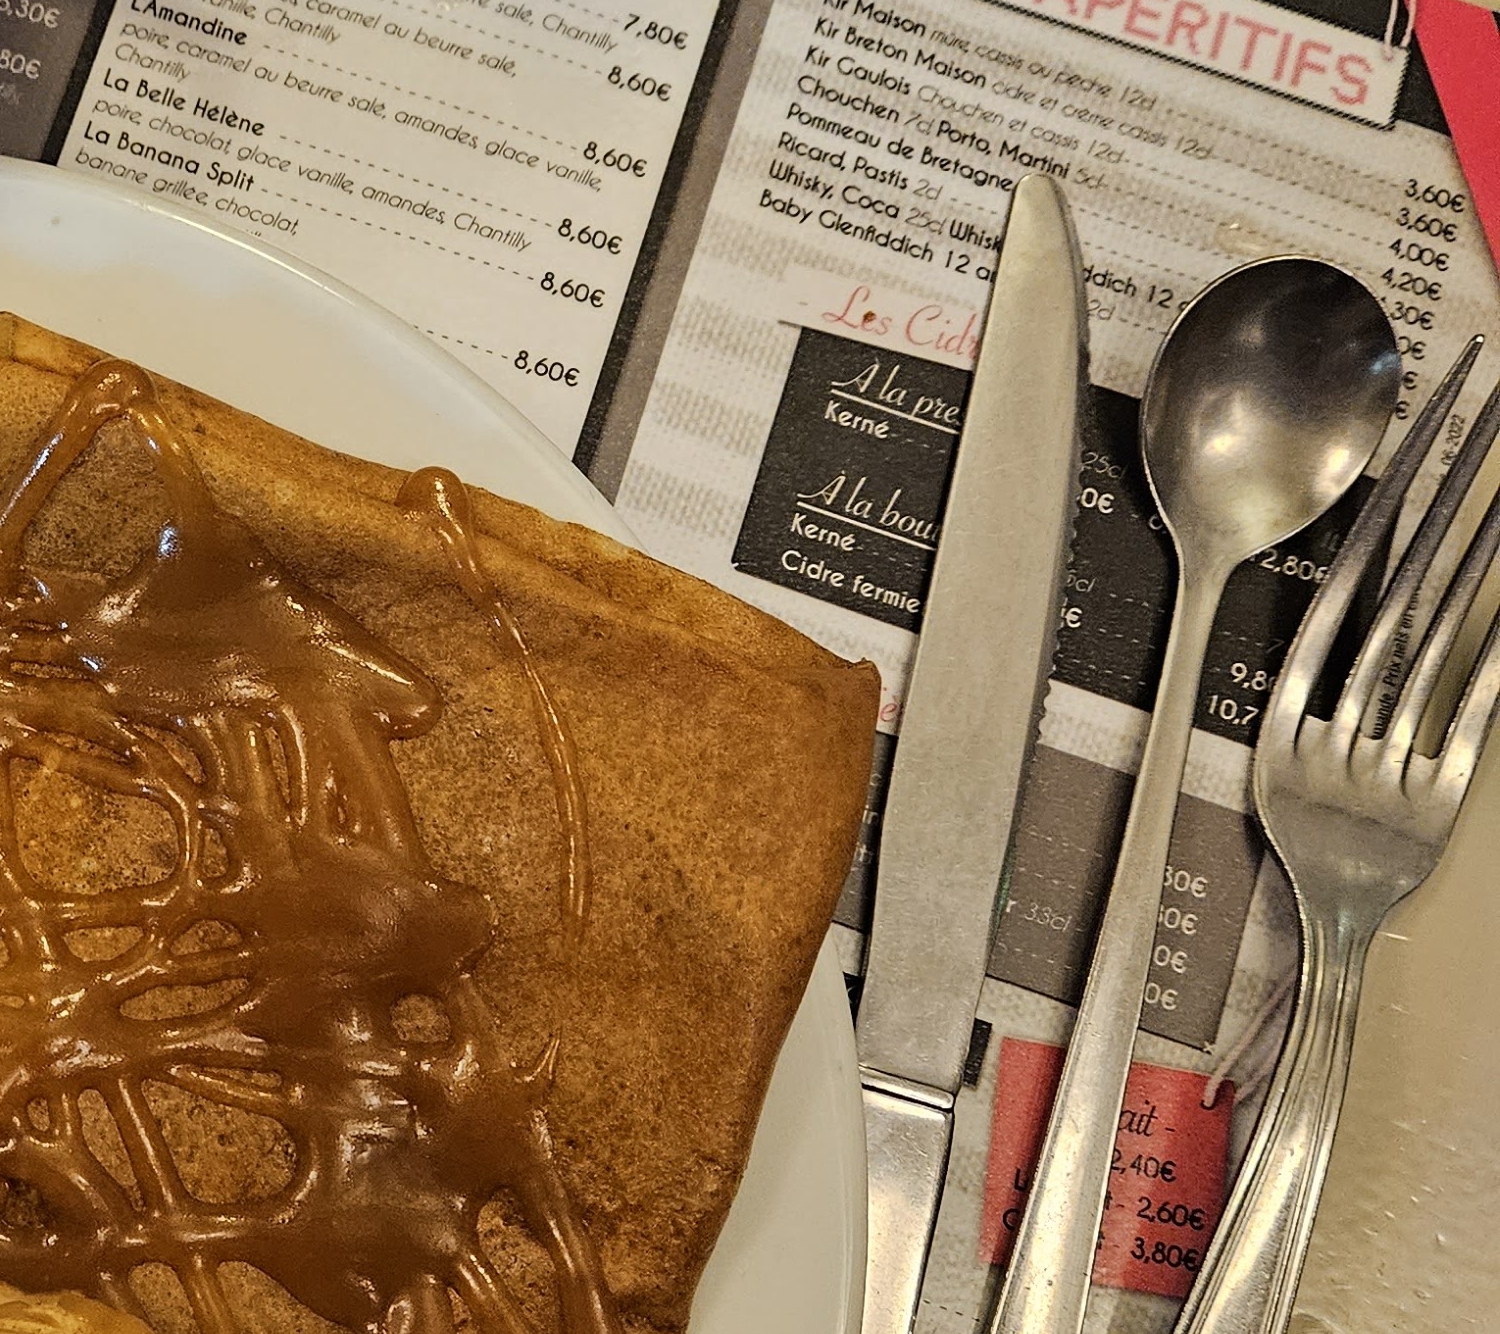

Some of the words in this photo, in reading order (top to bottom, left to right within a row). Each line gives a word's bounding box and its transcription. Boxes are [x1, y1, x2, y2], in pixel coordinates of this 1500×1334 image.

[624, 14, 686, 49] 7,80€
[607, 65, 670, 101] 8,60€
[787, 102, 880, 147] Pommeau
[886, 138, 915, 159] de
[920, 146, 1012, 191] Bretagne
[813, 17, 839, 39] Kir
[844, 26, 907, 61] Breton
[914, 49, 986, 86] Maison
[1396, 207, 1456, 242] 3,60€
[74, 148, 148, 183] banane
[102, 67, 130, 92] La
[136, 78, 185, 110] Belle
[193, 98, 263, 135] Hélène
[557, 218, 621, 254] 8,60€
[582, 141, 646, 177] 8,60€
[778, 131, 845, 170] Ricard,
[852, 156, 908, 190] Pastis
[804, 45, 831, 68] Kir
[836, 56, 909, 95] Gaulois
[1389, 238, 1448, 271] 4,00€
[83, 120, 111, 144] La
[117, 131, 199, 173] Banana
[206, 161, 253, 191] Split
[540, 271, 604, 307] 8,60€
[236, 145, 291, 171] glace
[453, 212, 530, 251] Chantilly
[768, 160, 833, 198] Whisky,
[841, 184, 899, 218] Coca
[797, 75, 899, 121] Chouchen
[936, 119, 993, 155] Porto,
[998, 140, 1069, 178] Martini
[1381, 267, 1441, 301] 4,20€
[1405, 179, 1465, 212] 3,60€
[759, 189, 812, 223] Baby
[943, 250, 970, 274] 12
[823, 286, 893, 334] Les
[514, 350, 579, 386] 8,60€
[824, 400, 888, 438] Kerné
[790, 513, 854, 550] Kerné
[781, 550, 844, 586] Cidre
[852, 575, 919, 612] fermie
[1134, 1196, 1204, 1230] 2,60€
[1128, 1235, 1198, 1272] 3,80€
